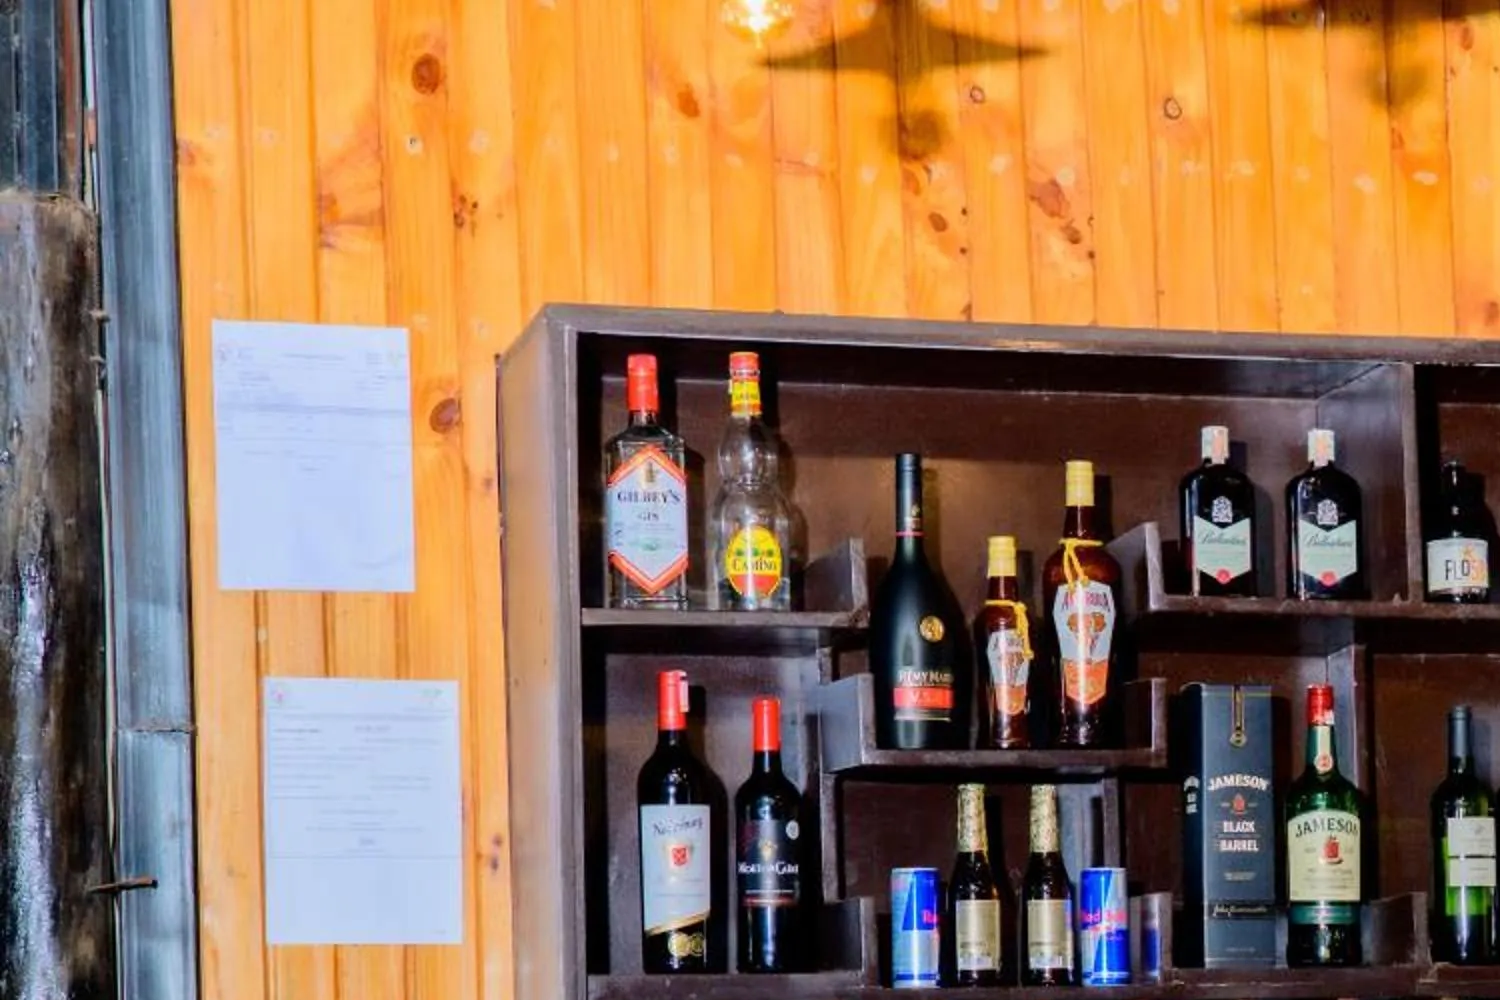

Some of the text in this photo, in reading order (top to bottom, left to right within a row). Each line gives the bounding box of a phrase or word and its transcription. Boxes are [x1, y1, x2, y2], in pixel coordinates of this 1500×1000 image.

[1208, 774, 1270, 791] JAMESON
[1222, 821, 1256, 833] BLACK
[1219, 839, 1260, 852] BARREL
